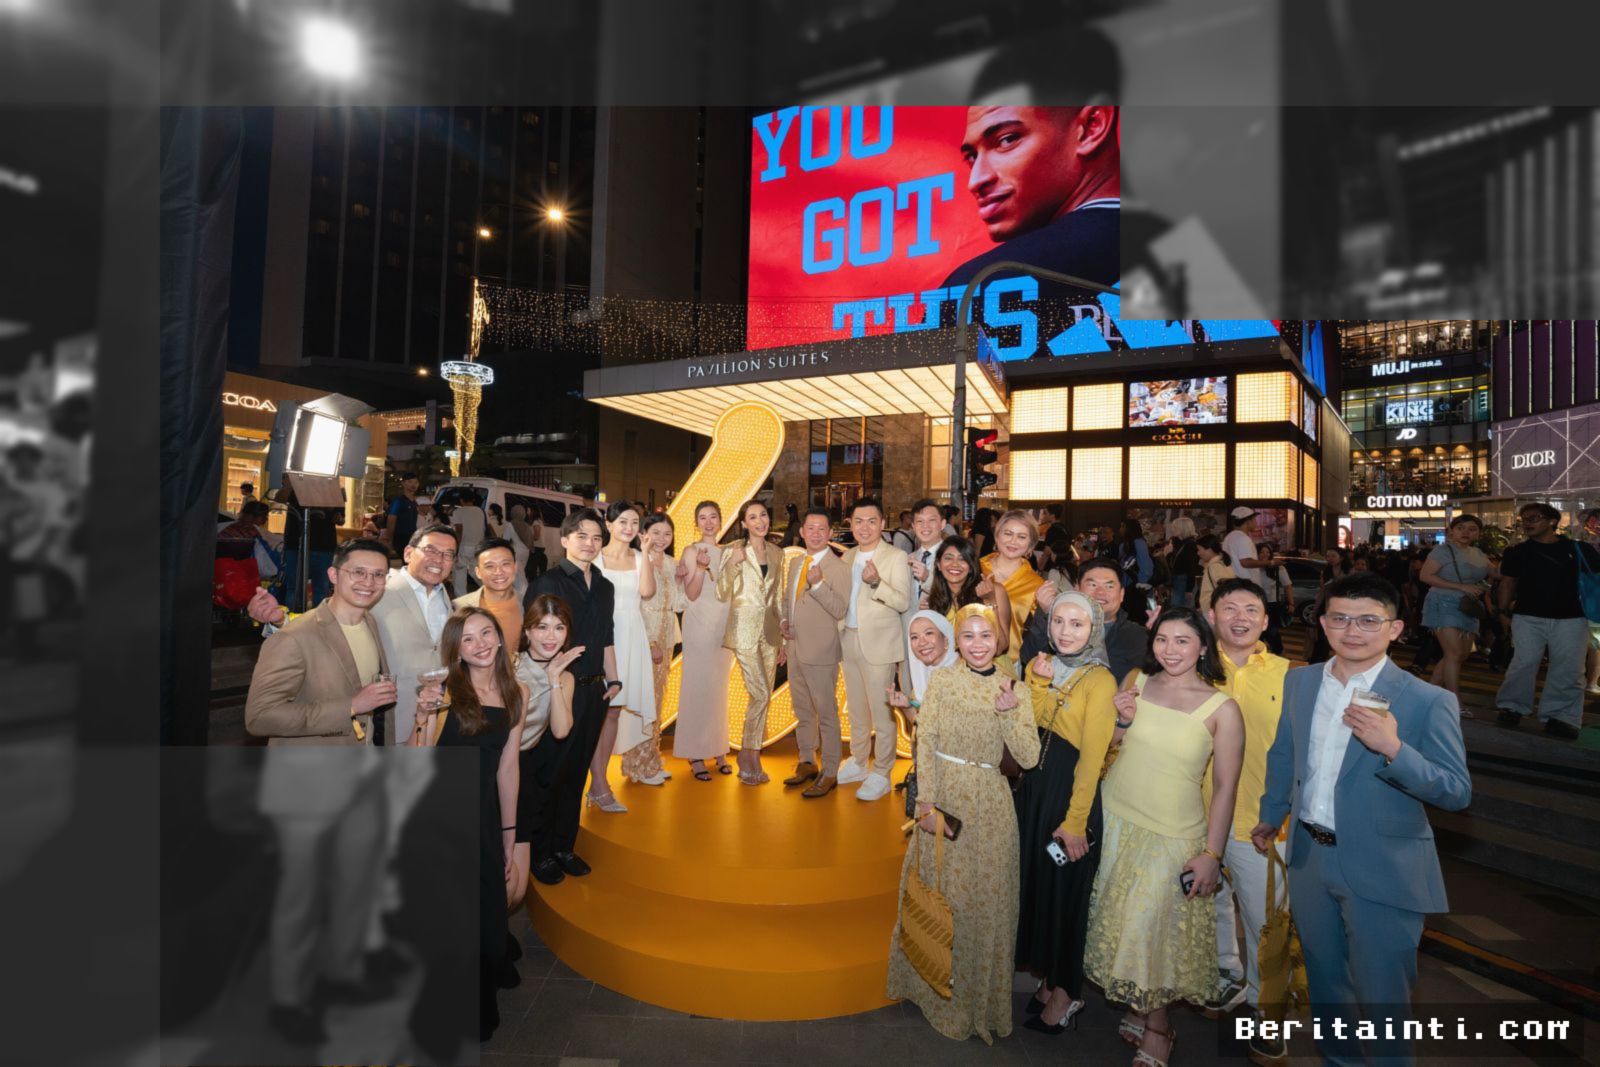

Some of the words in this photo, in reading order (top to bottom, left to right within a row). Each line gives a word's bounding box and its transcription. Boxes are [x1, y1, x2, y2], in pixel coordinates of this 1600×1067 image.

[753, 106, 894, 183] YOU
[802, 172, 955, 275] GOT
[768, 351, 829, 369] SUITES
[1372, 360, 1410, 377] MUJI
[1386, 404, 1434, 419] KING
[1152, 433, 1202, 441] COACH
[1396, 427, 1418, 440] JD
[1511, 449, 1556, 470] DIOR
[1367, 495, 1423, 509] COTTON
[1427, 494, 1448, 508] ON
